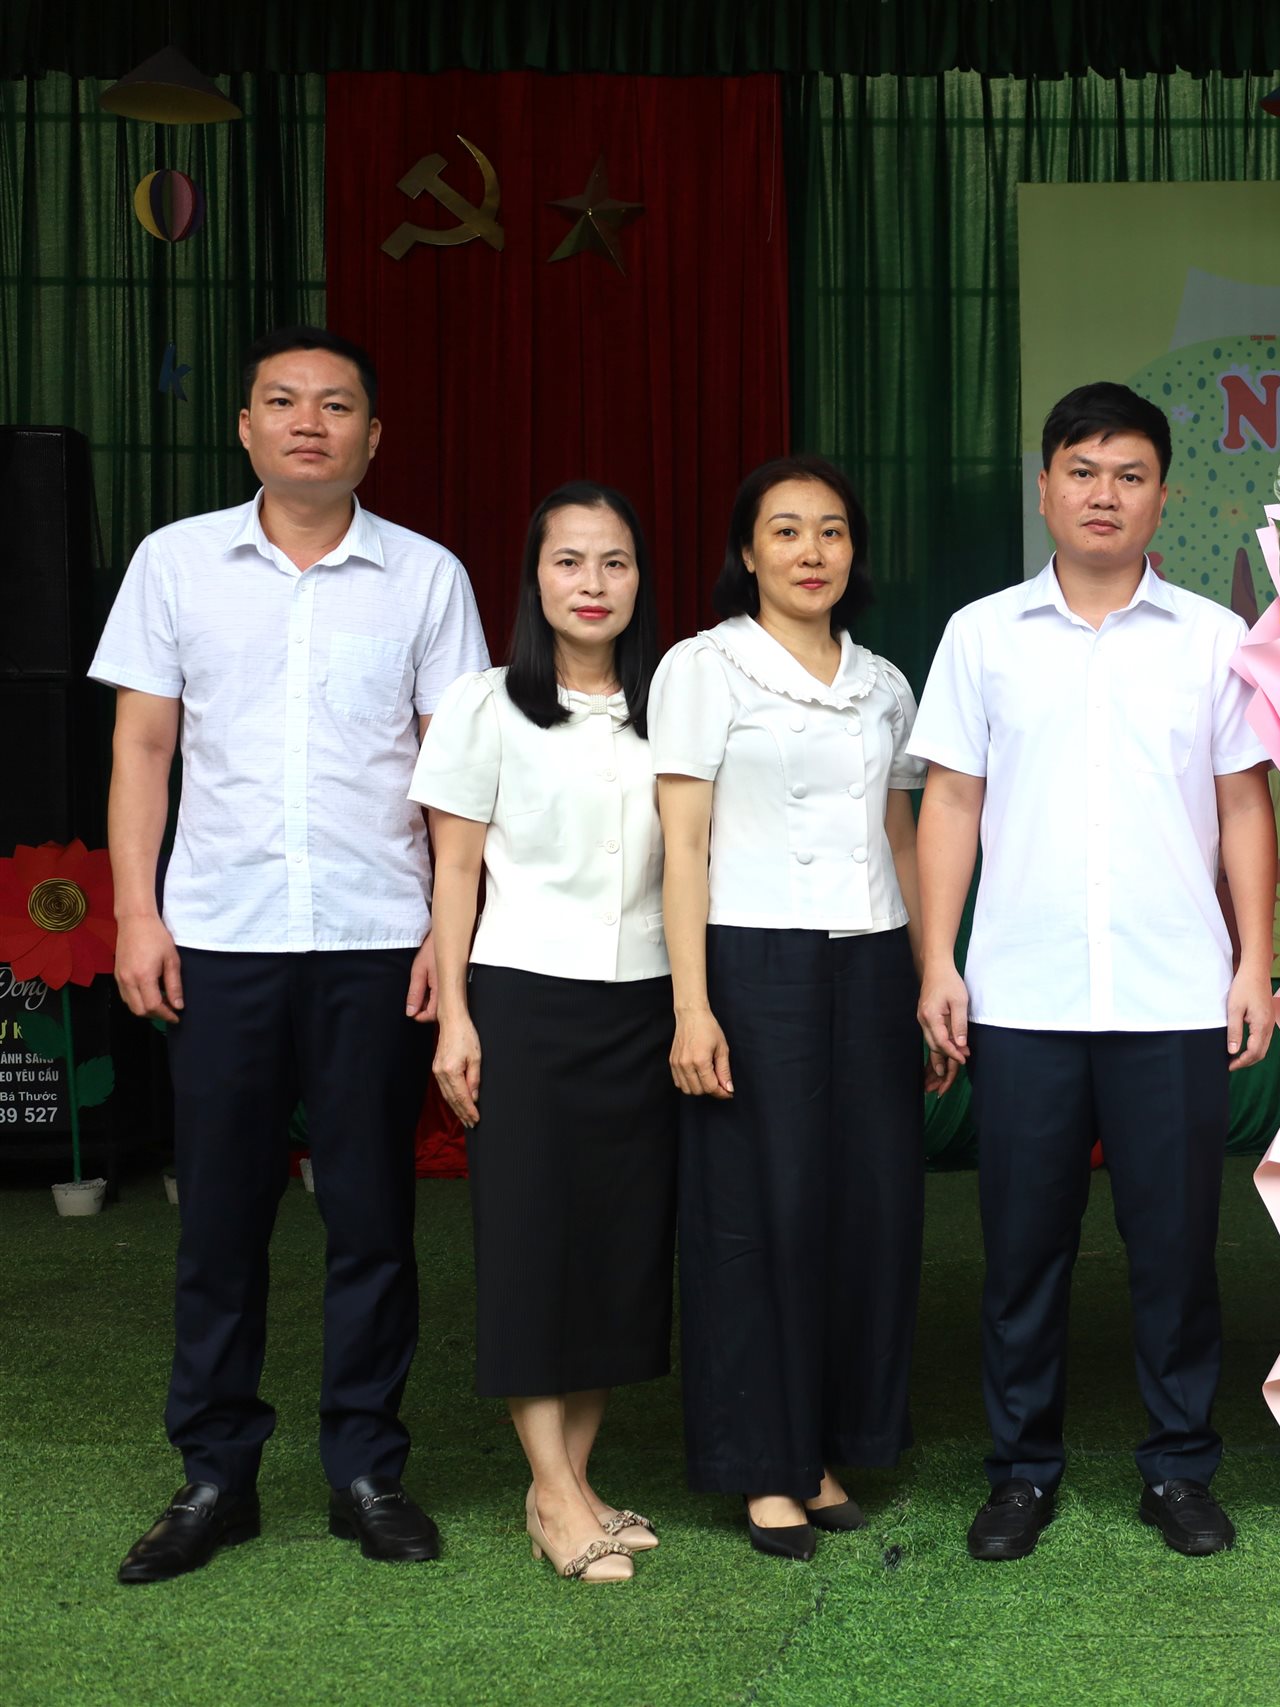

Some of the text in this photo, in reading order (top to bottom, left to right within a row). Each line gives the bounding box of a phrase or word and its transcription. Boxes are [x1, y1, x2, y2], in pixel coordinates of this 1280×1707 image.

[15, 1068, 35, 1082] YÊU
[18, 1091, 57, 1101] Thước
[24, 1107, 58, 1123] 527
